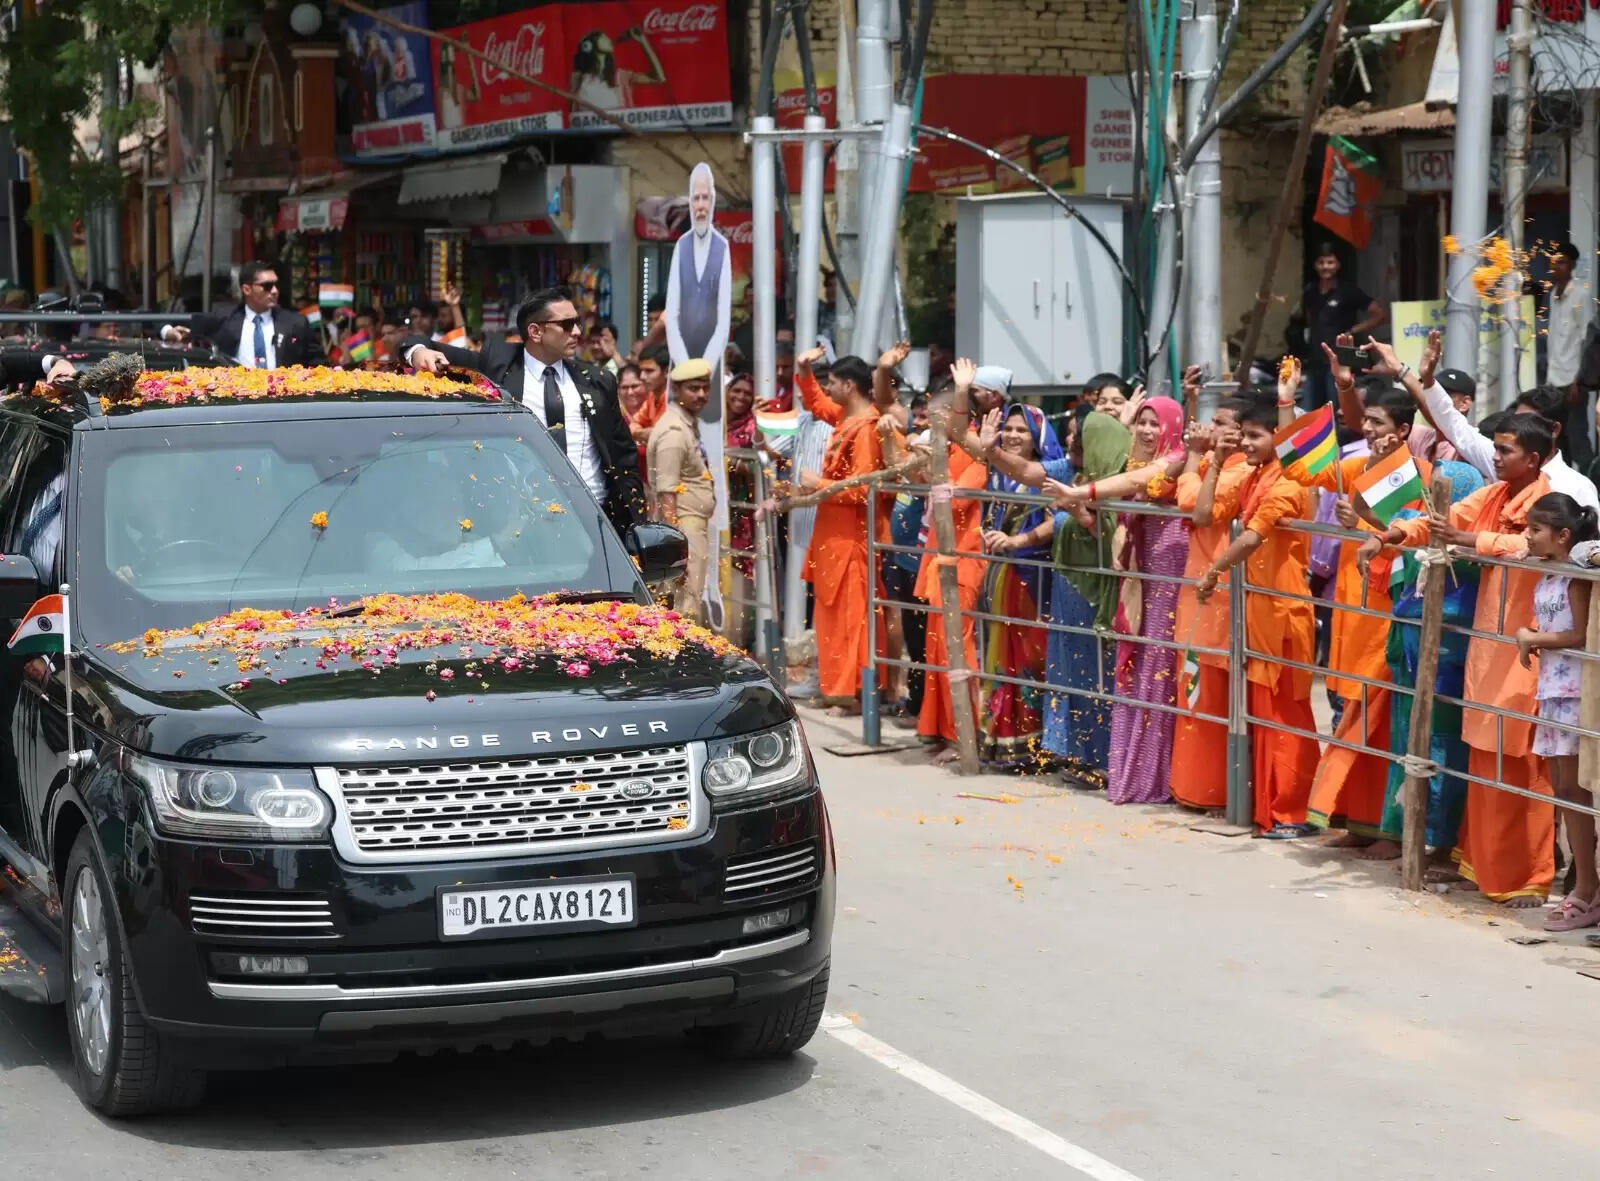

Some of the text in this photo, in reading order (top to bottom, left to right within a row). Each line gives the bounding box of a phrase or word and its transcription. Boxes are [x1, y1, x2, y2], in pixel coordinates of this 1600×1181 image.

[521, 113, 548, 130] STORE
[627, 106, 683, 124] GENERAL
[686, 104, 726, 119] STORE
[352, 720, 669, 751] RANGE ROVER
[630, 788, 649, 796] ROVER
[446, 908, 461, 917] IND
[463, 887, 627, 926] DL2CAX8121
